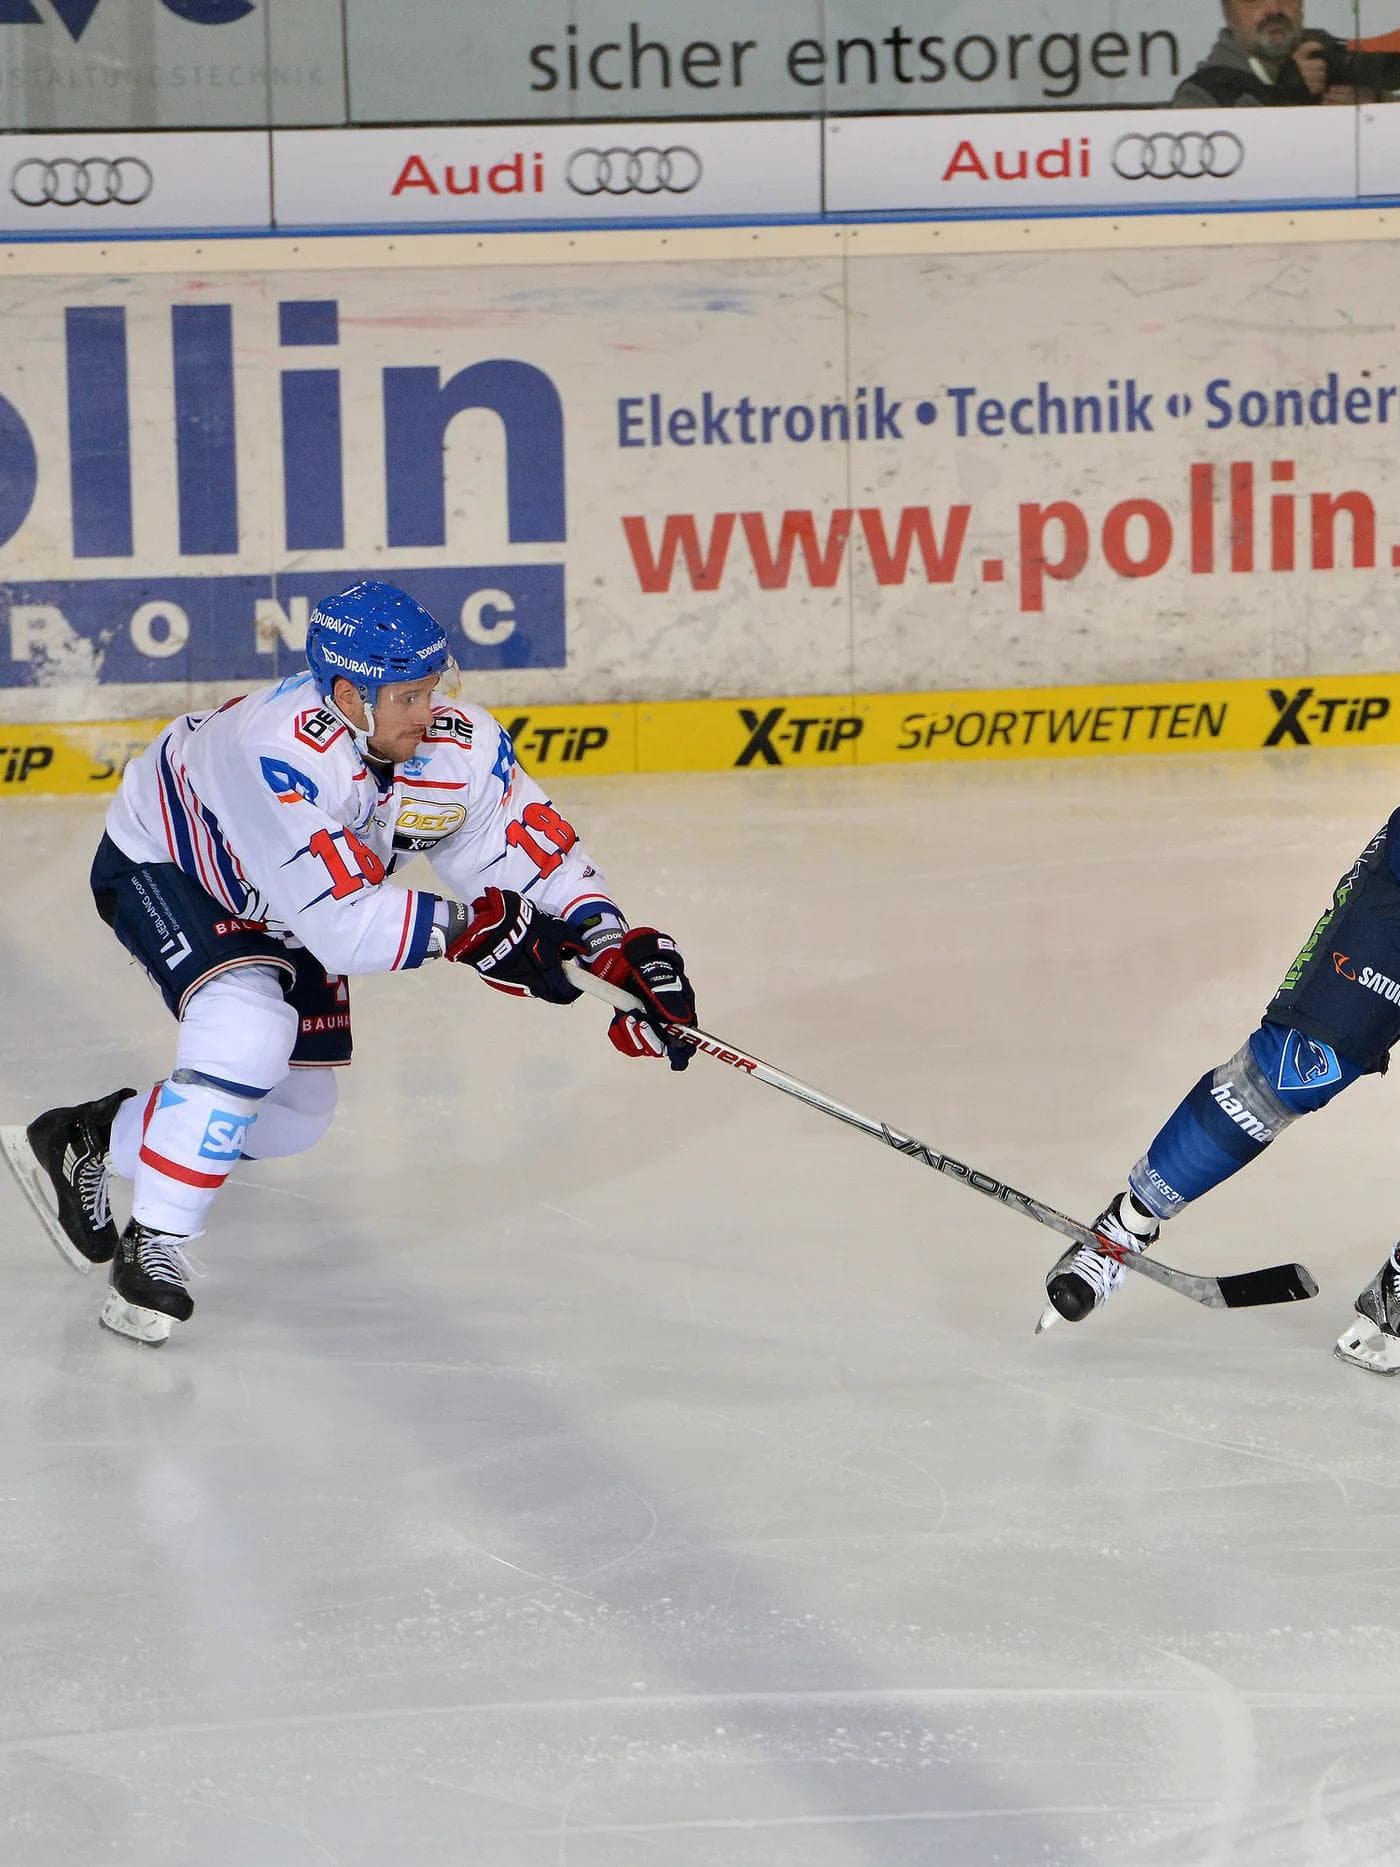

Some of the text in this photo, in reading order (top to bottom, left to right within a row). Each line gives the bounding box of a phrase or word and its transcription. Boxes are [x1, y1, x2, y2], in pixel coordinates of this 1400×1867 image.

[529, 23, 1181, 98] sicher entsorgen
[390, 152, 546, 196] Audi
[942, 138, 1091, 181] Audi
[617, 387, 904, 448] Elektronik
[948, 378, 1155, 437] Technik
[9, 588, 516, 663] RONC
[335, 655, 385, 679] DURAVIT
[505, 717, 609, 764] -TiP
[896, 702, 1229, 750] SPORTWETTEN
[395, 810, 449, 832] DEL
[505, 802, 577, 880] 18
[130, 875, 173, 942] LIEBLANG.com
[589, 932, 623, 949] Reebok
[1209, 1081, 1274, 1143] hama
[202, 1119, 249, 1154] SA
